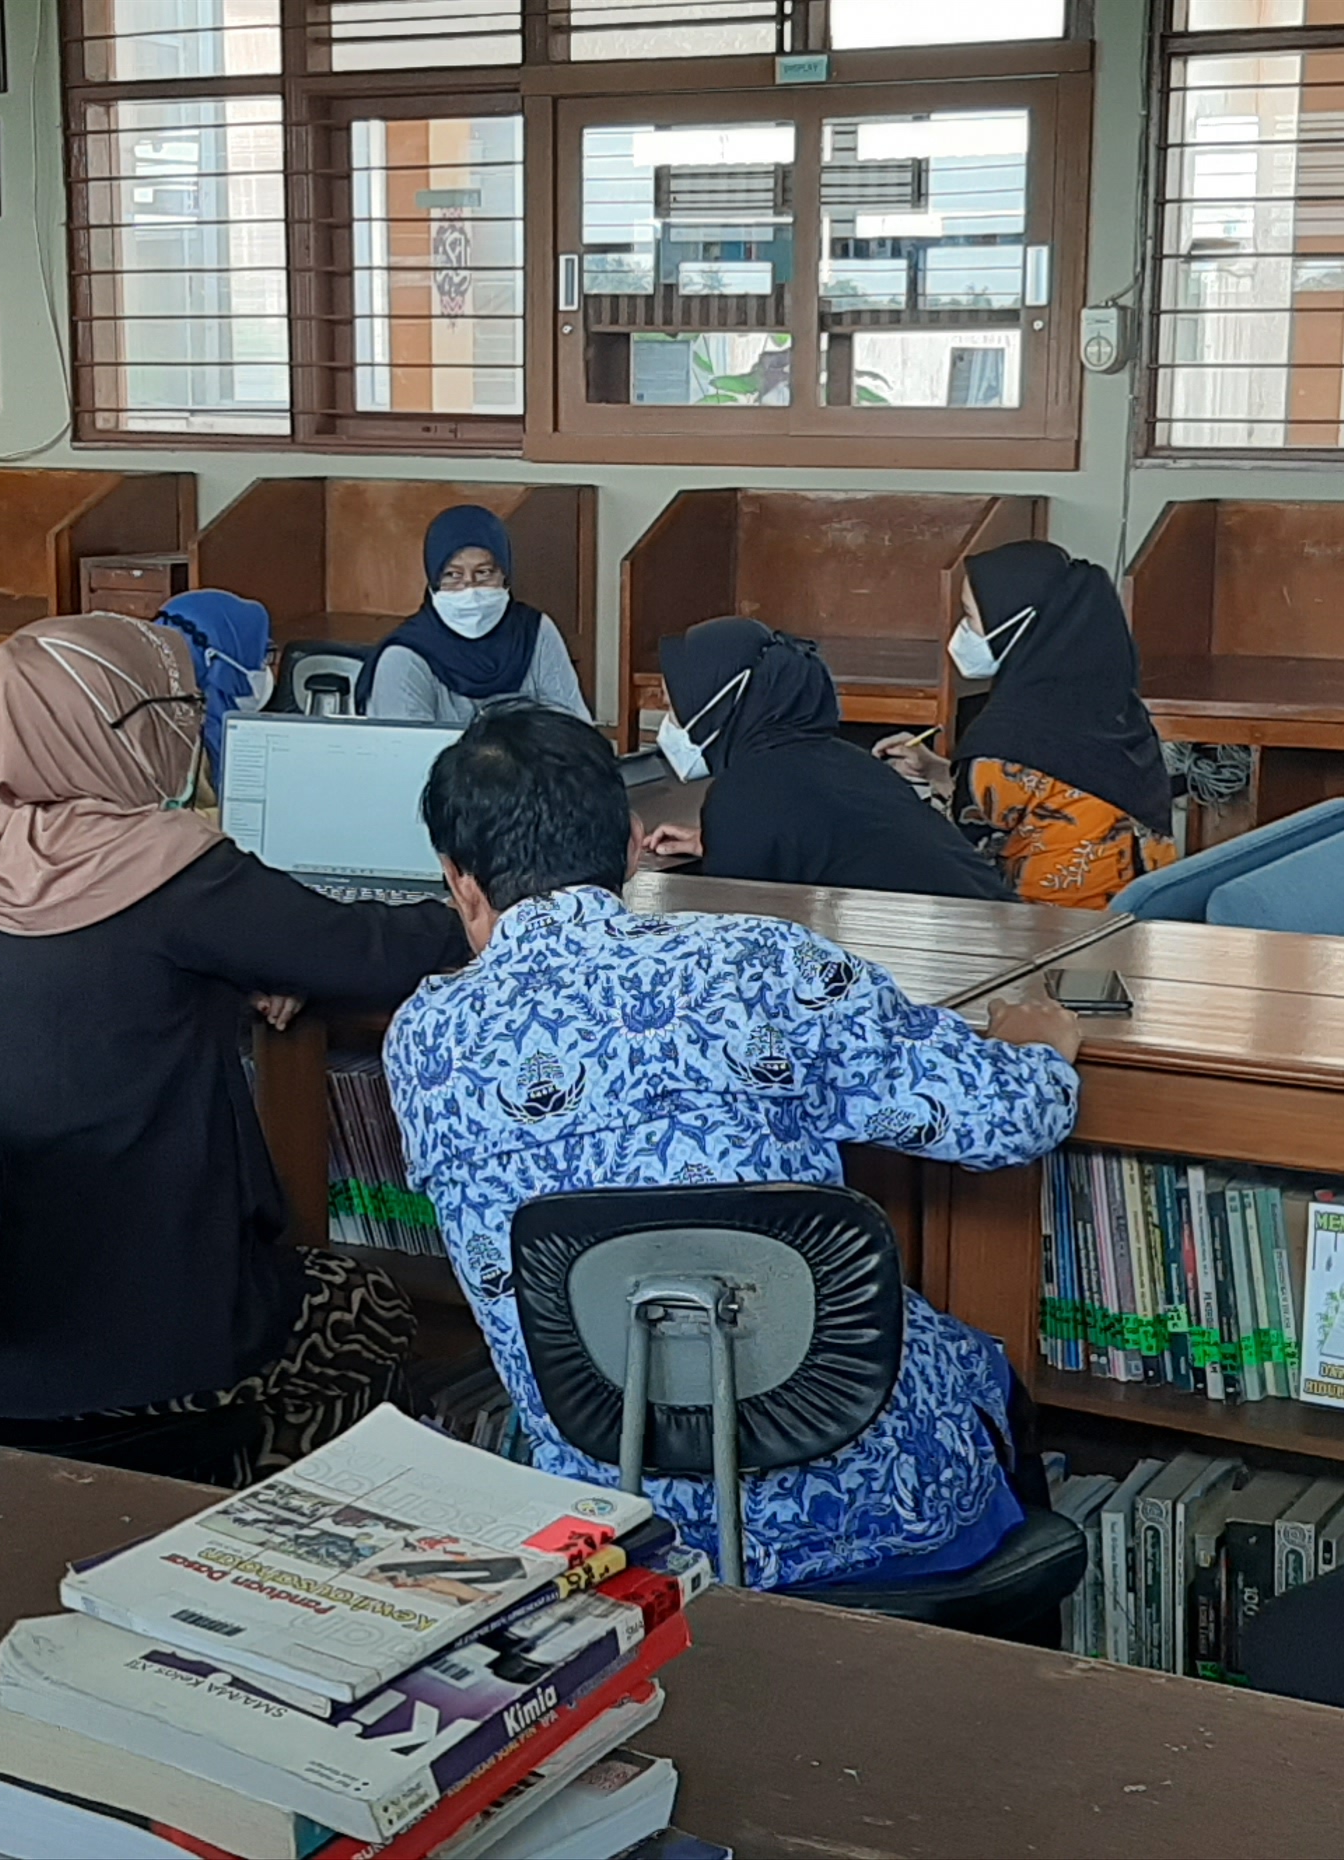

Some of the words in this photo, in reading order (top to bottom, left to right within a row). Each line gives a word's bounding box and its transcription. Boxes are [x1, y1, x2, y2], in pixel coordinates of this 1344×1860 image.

[160, 1553, 229, 1582] Dasar
[198, 1546, 437, 1631] Kewirausahaan
[231, 1575, 336, 1615] Panduan
[155, 1664, 207, 1688] Kelas
[207, 1682, 289, 1719] SMA/MA
[502, 1683, 559, 1739] Kimia
